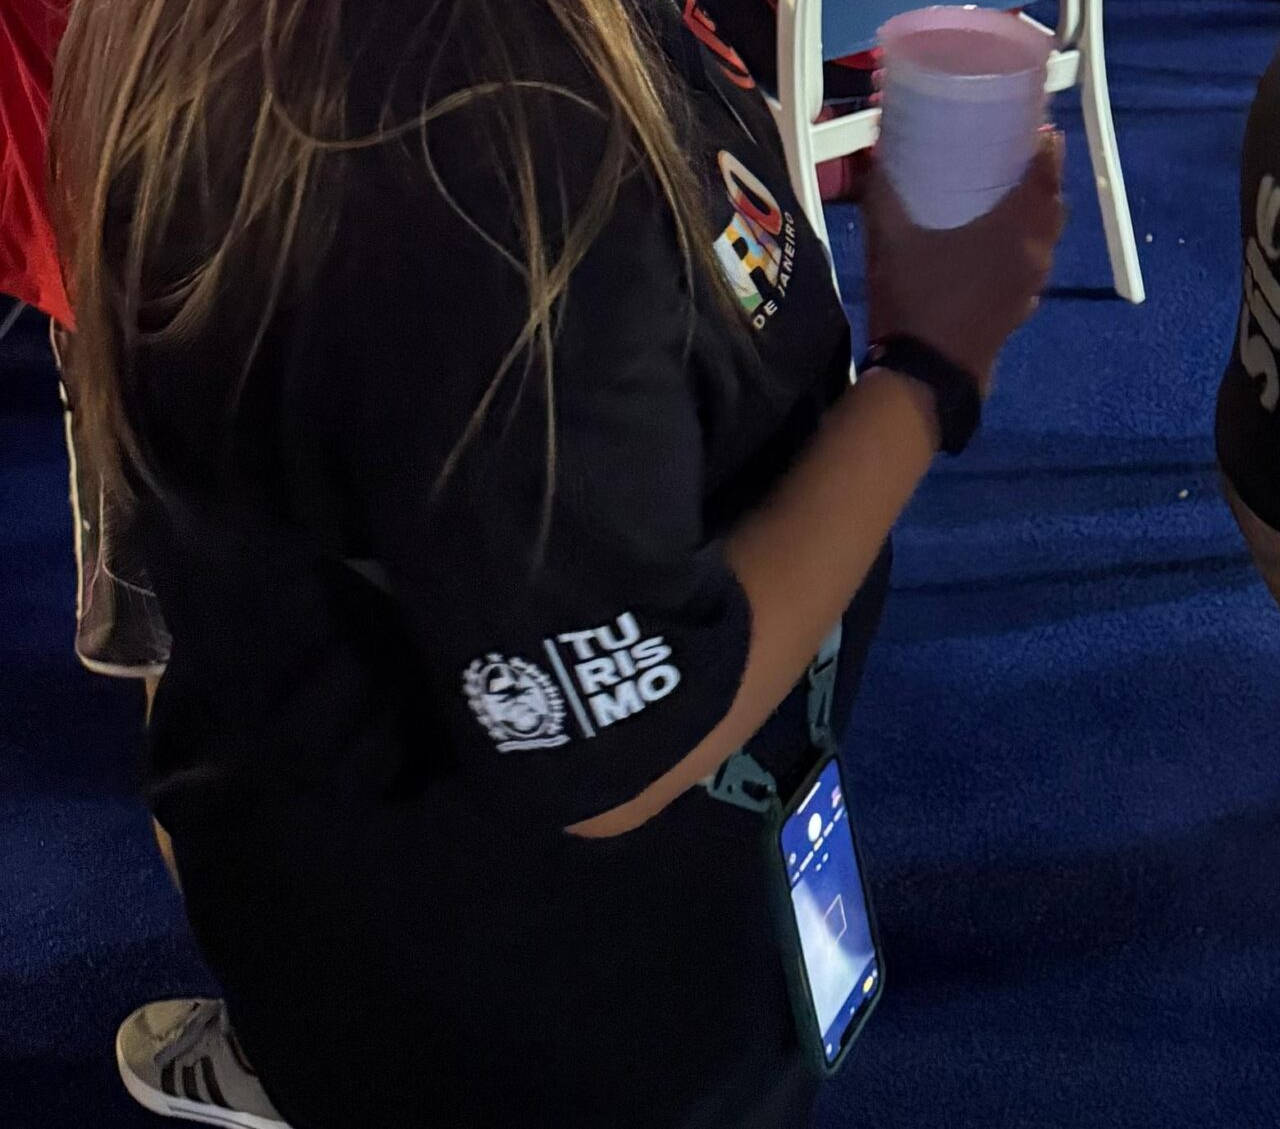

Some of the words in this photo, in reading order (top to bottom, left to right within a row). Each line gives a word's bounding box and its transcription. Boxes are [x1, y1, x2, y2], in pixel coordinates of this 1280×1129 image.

[752, 299, 778, 330] DE
[777, 211, 796, 298] JANEIRO
[557, 611, 641, 660] TU
[574, 636, 672, 695] RIS
[588, 664, 681, 728] MO
